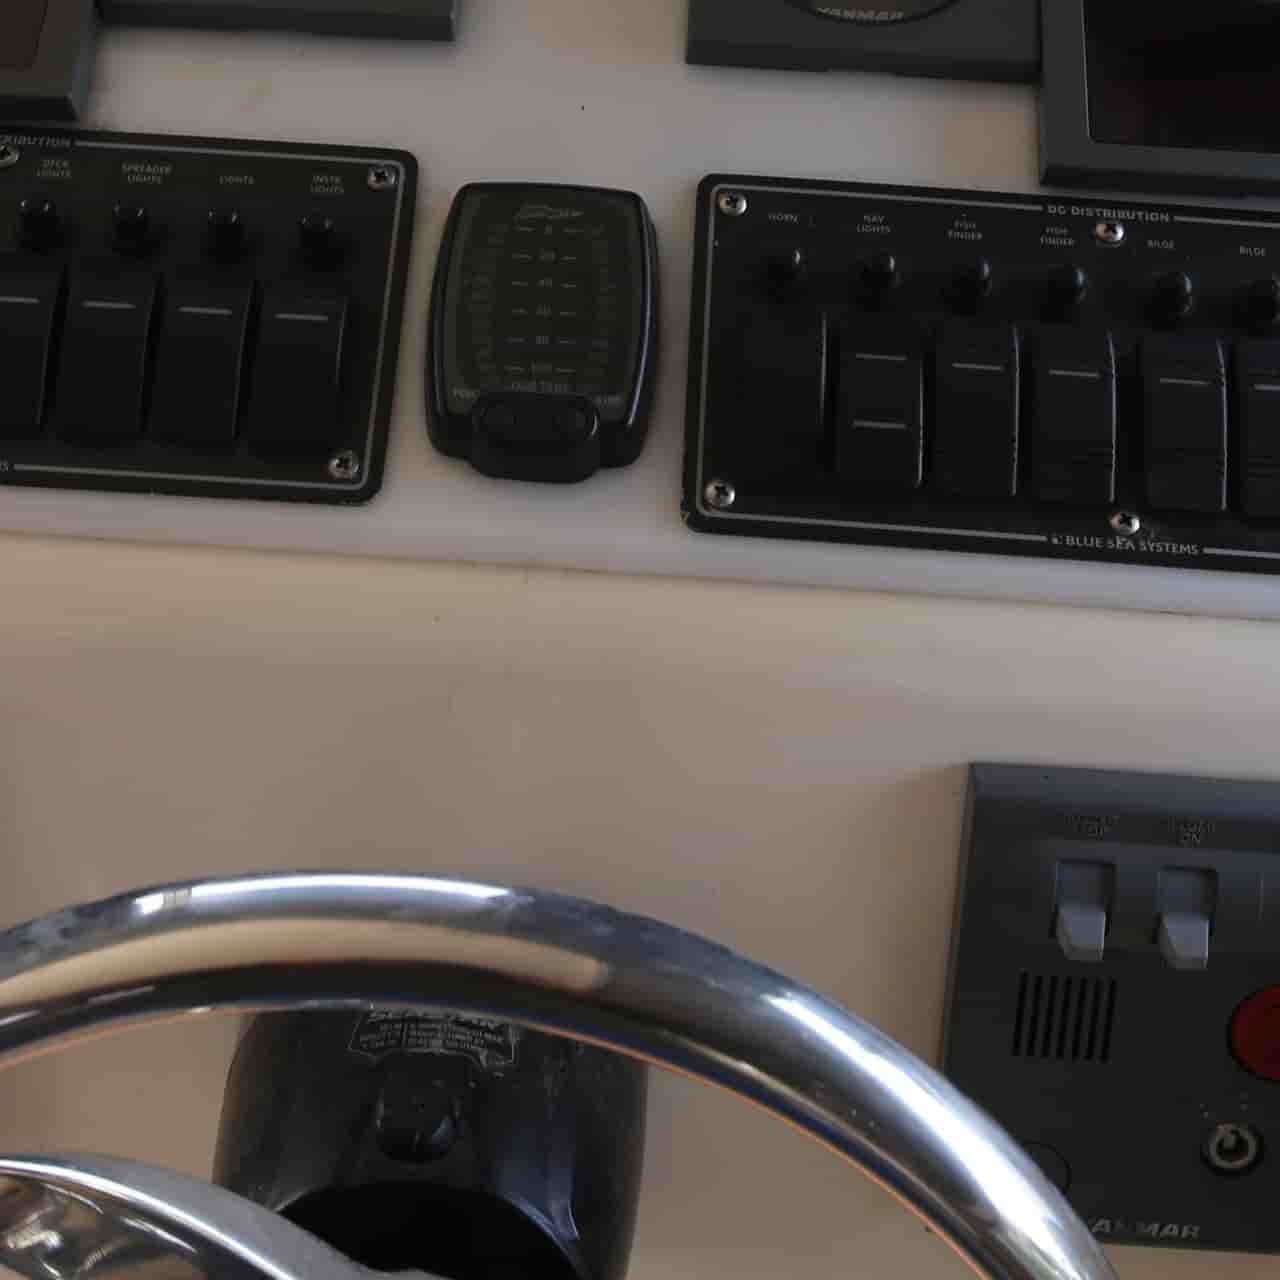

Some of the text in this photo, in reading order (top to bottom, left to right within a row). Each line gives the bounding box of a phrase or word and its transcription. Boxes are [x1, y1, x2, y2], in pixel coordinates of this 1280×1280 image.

[1070, 205, 1171, 225] DISTRIBUTION
[1064, 534, 1105, 548] BLUE
[1139, 540, 1202, 554] SYSTEMS
[1086, 1218, 1201, 1240] AMAR
